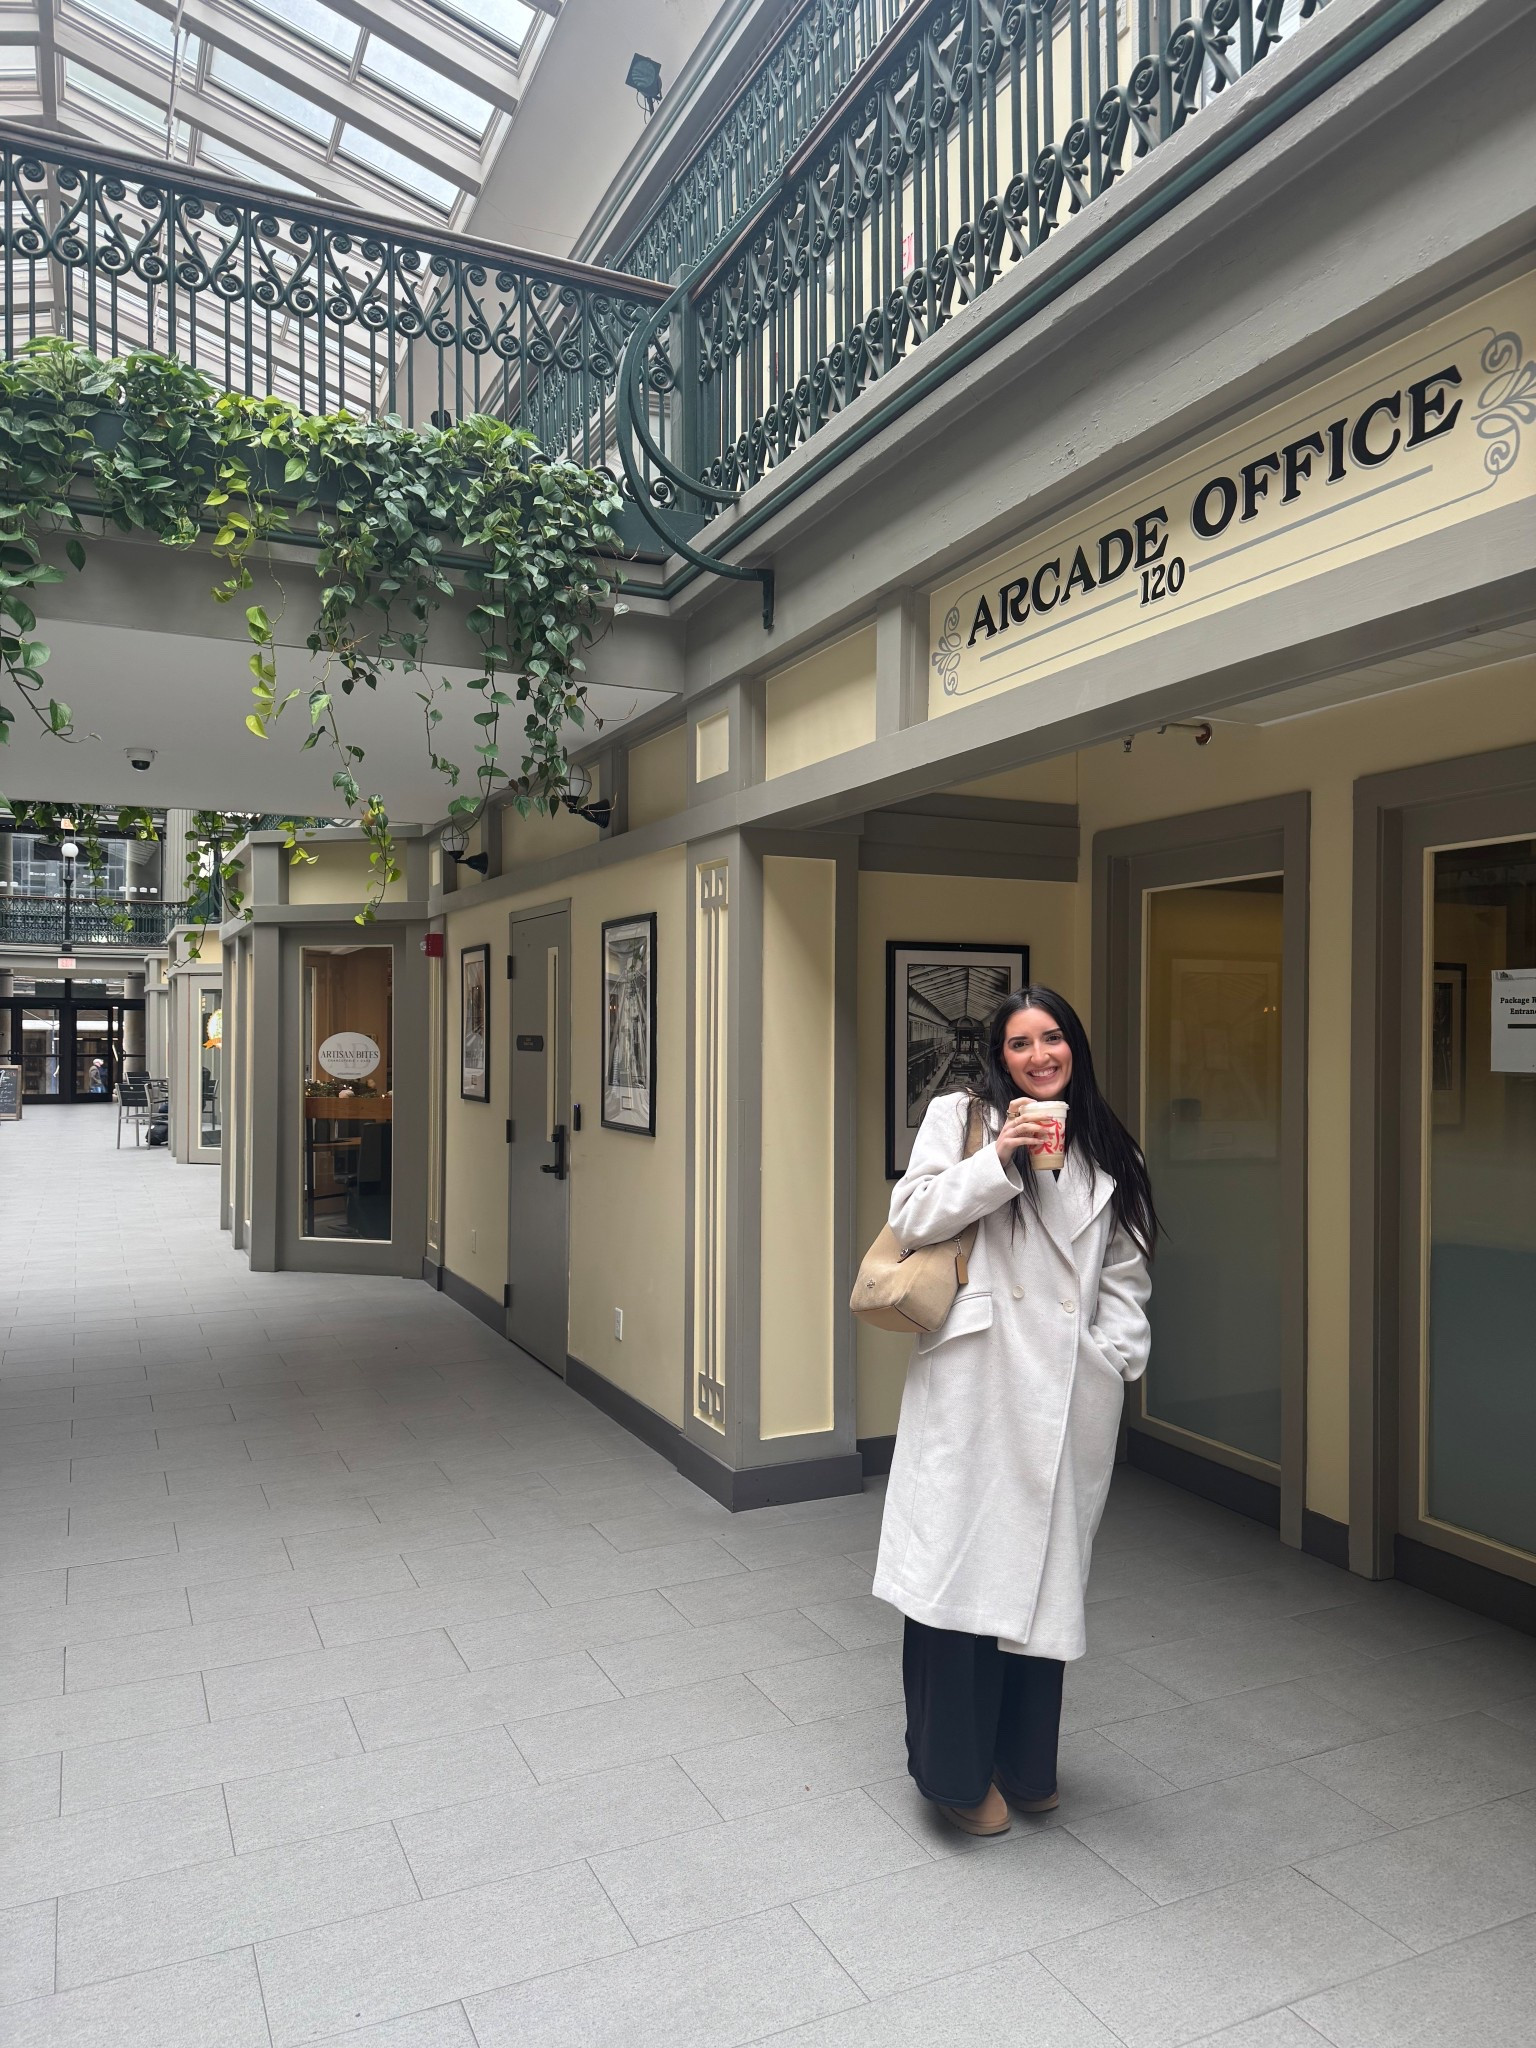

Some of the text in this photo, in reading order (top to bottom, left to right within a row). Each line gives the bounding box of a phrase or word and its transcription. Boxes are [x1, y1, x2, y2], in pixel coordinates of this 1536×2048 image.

[966, 364, 1464, 647] ARCADE OFFICE
[1140, 556, 1186, 605] 120
[1500, 997, 1530, 1005] Package
